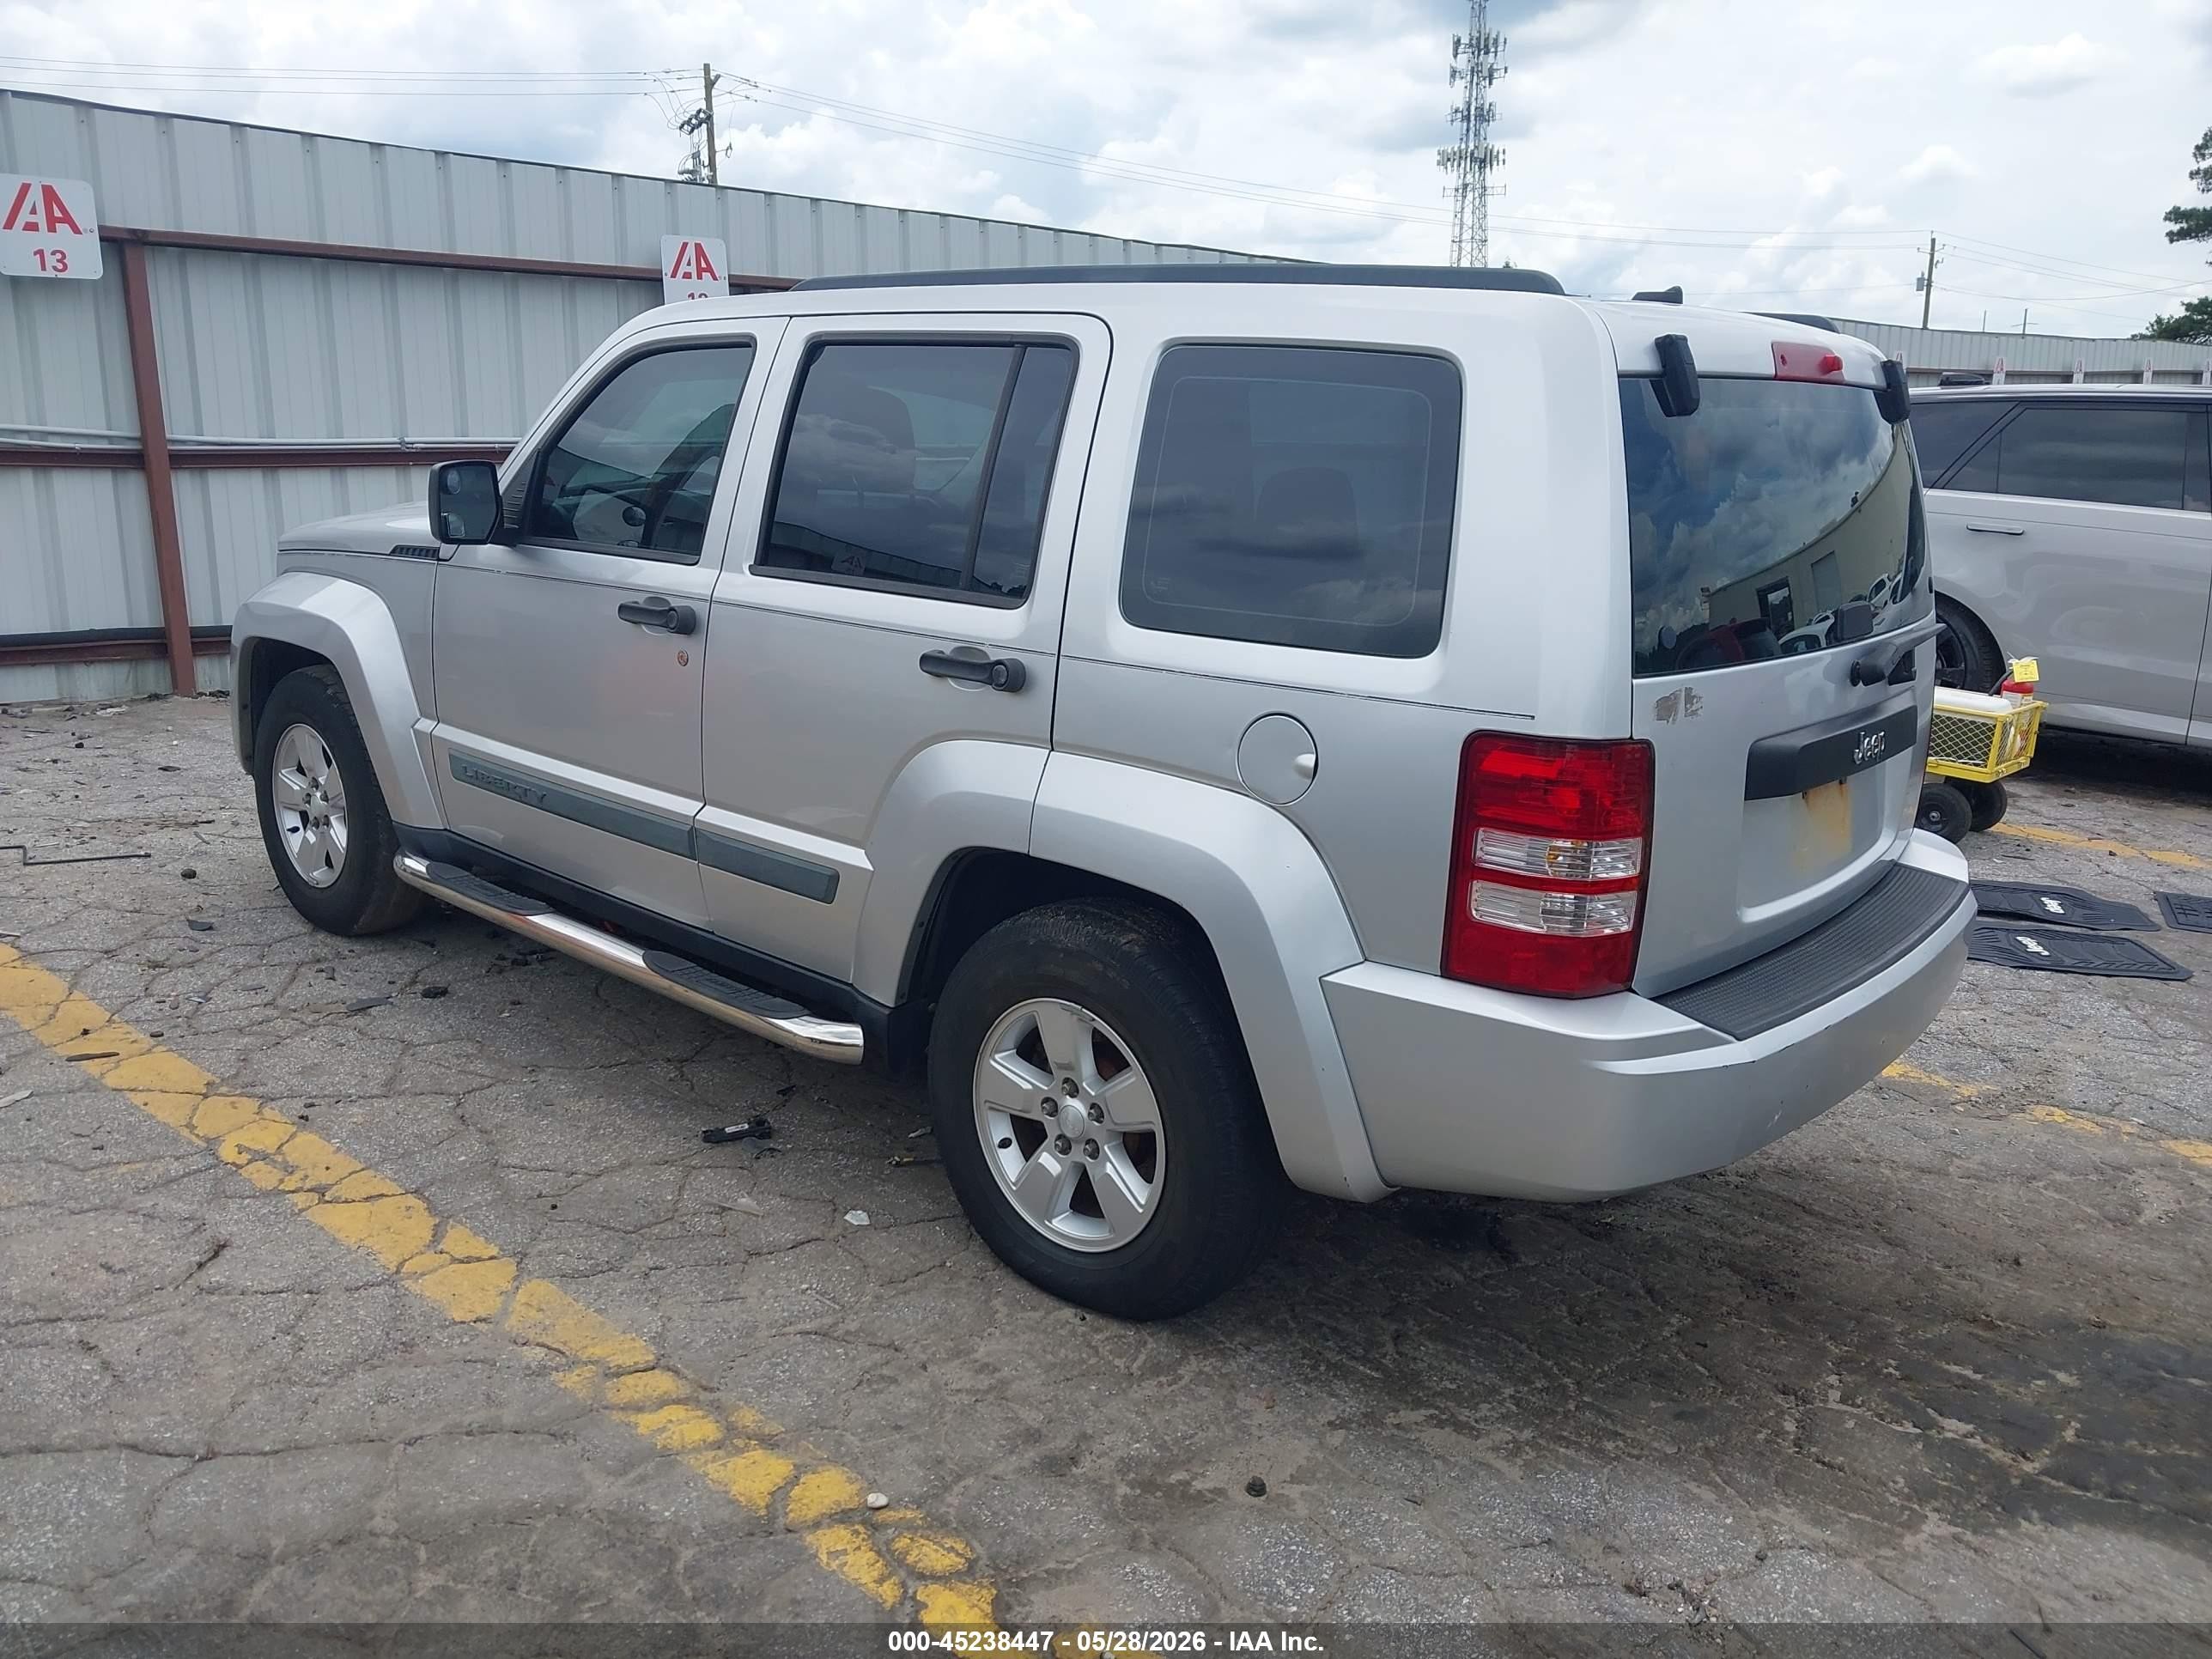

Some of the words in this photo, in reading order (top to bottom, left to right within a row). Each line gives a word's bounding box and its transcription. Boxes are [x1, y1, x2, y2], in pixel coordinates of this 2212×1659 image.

[33, 248, 68, 273] 13
[1853, 731, 1885, 764] Jeep
[461, 763, 547, 806] LIBERTY
